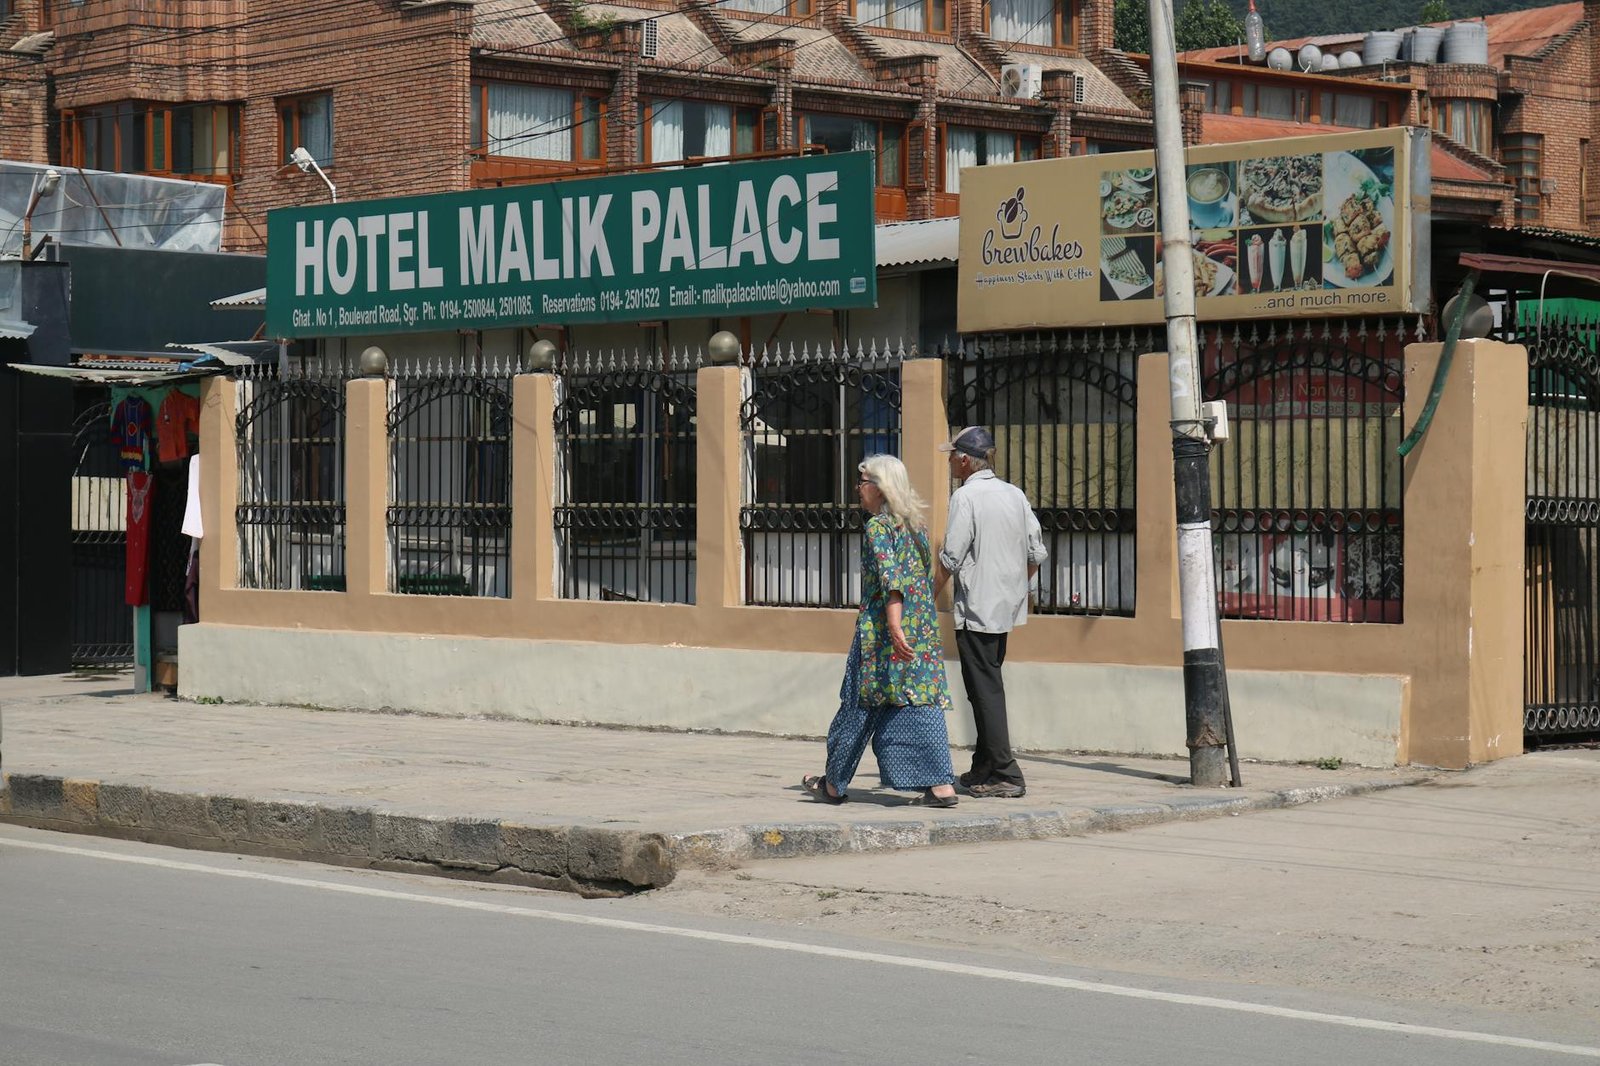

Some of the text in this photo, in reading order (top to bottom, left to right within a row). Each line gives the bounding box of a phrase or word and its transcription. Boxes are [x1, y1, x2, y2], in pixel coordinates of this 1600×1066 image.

[295, 170, 841, 296] HOTEL MALIK PALACE
[982, 223, 1083, 266] brewbakes
[976, 267, 1093, 288] Happiness Starts With Coffee
[316, 308, 327, 326] No
[339, 305, 378, 326] Boulevard
[379, 303, 402, 326] Road,
[403, 303, 419, 327] Sgr.
[422, 301, 436, 321] Ph:
[542, 291, 596, 314] Reservations
[625, 287, 660, 309] 2501522
[702, 277, 841, 309] malikpalacehotel@yahoo.com
[1300, 292, 1341, 307] much
[1347, 291, 1391, 304] more.
[1331, 383, 1356, 400] Veg
[1312, 403, 1354, 415] Snacs
